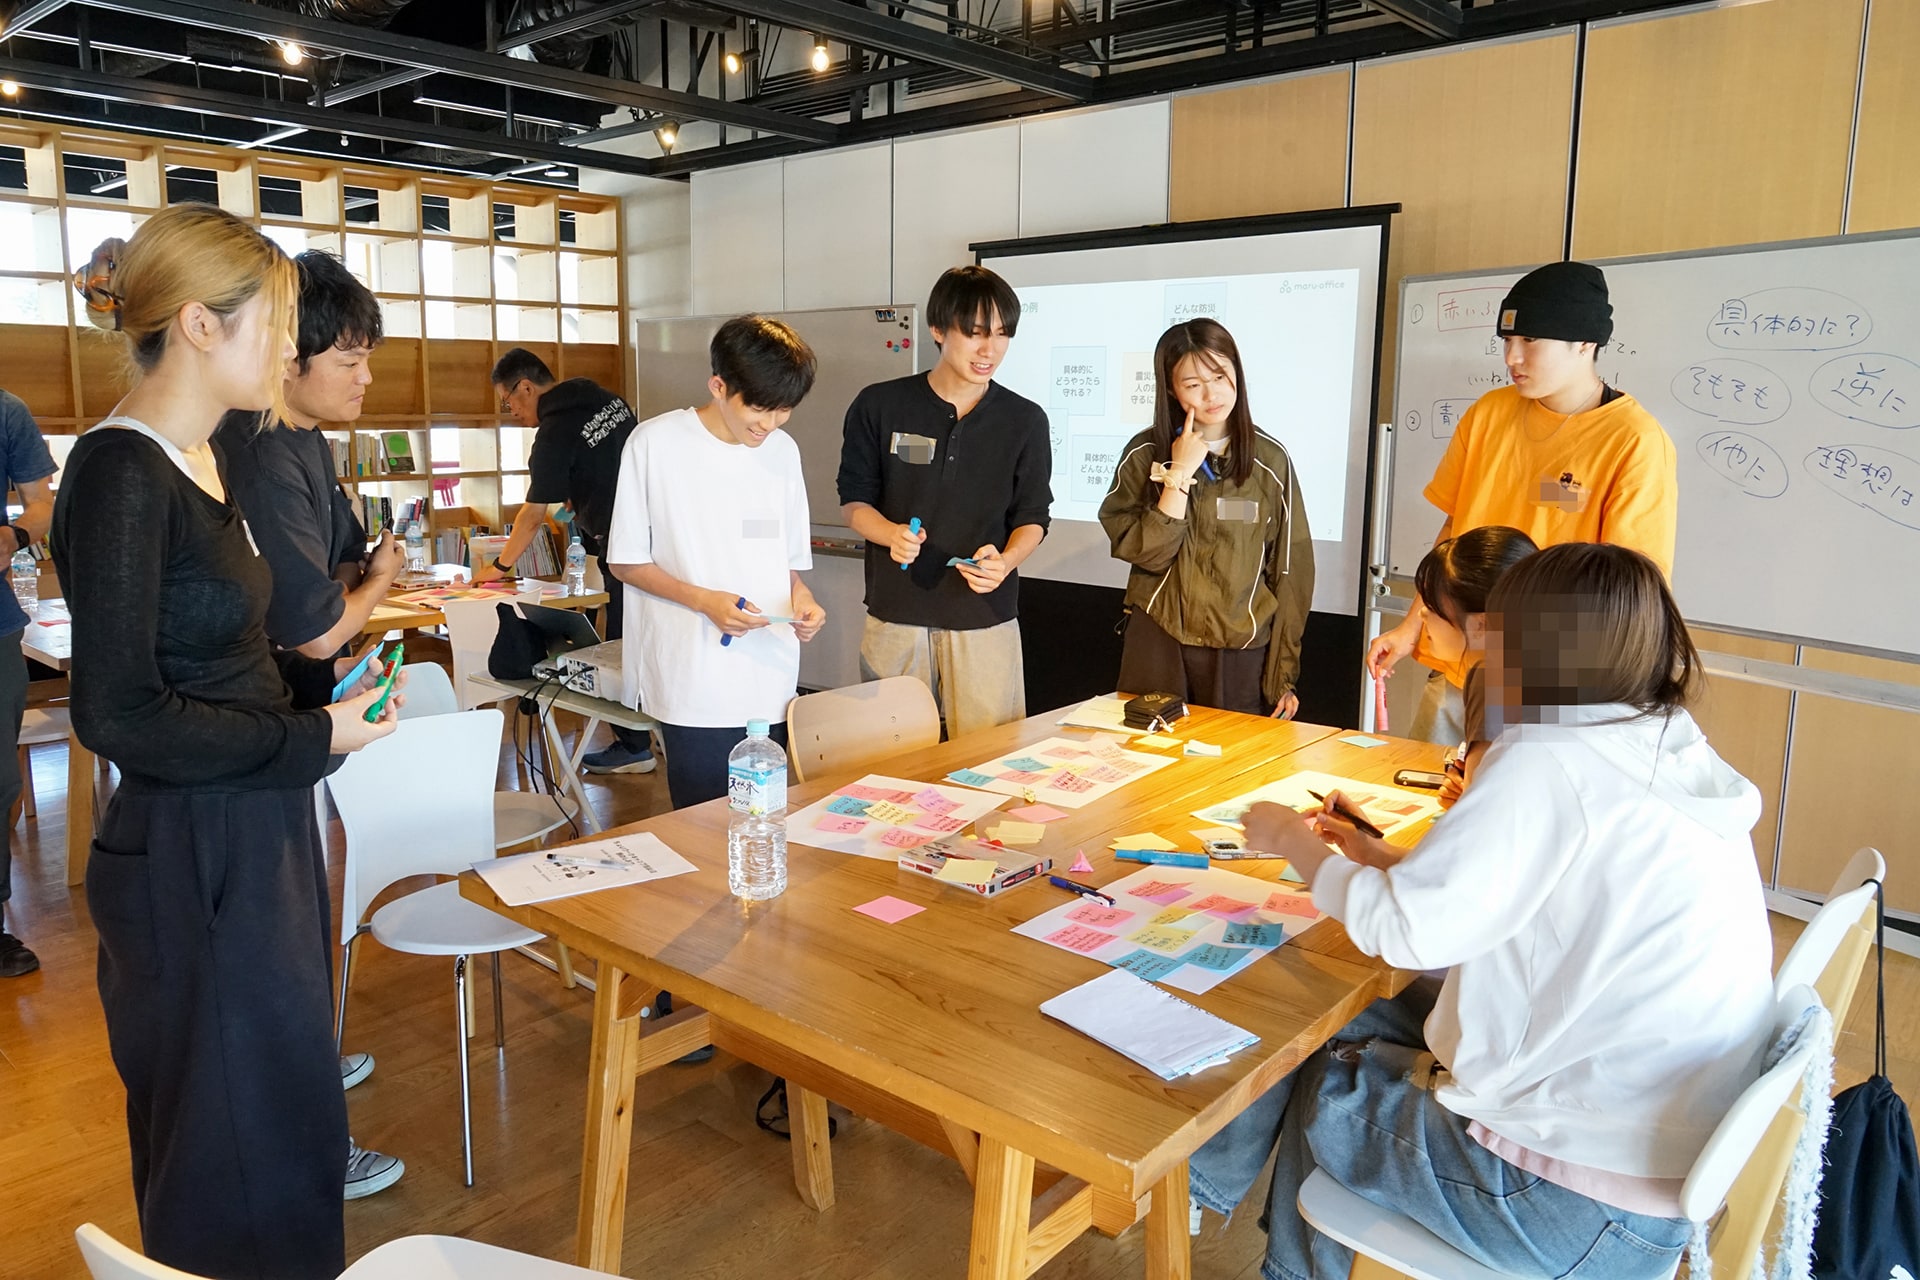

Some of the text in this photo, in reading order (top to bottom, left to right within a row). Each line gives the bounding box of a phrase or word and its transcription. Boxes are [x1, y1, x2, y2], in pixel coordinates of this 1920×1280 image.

[1174, 303, 1217, 314] どんな防災
[1063, 365, 1093, 374] 具体的に
[1056, 376, 1100, 386] どうやったら
[1062, 388, 1092, 397] 守れる？
[1689, 366, 1769, 410] そもそも
[1830, 362, 1907, 413] 逆に
[1084, 453, 1115, 463] 具体的に
[1706, 436, 1765, 481] 他に
[1087, 475, 1109, 485] 対象？
[1817, 446, 1913, 506] 理想は
